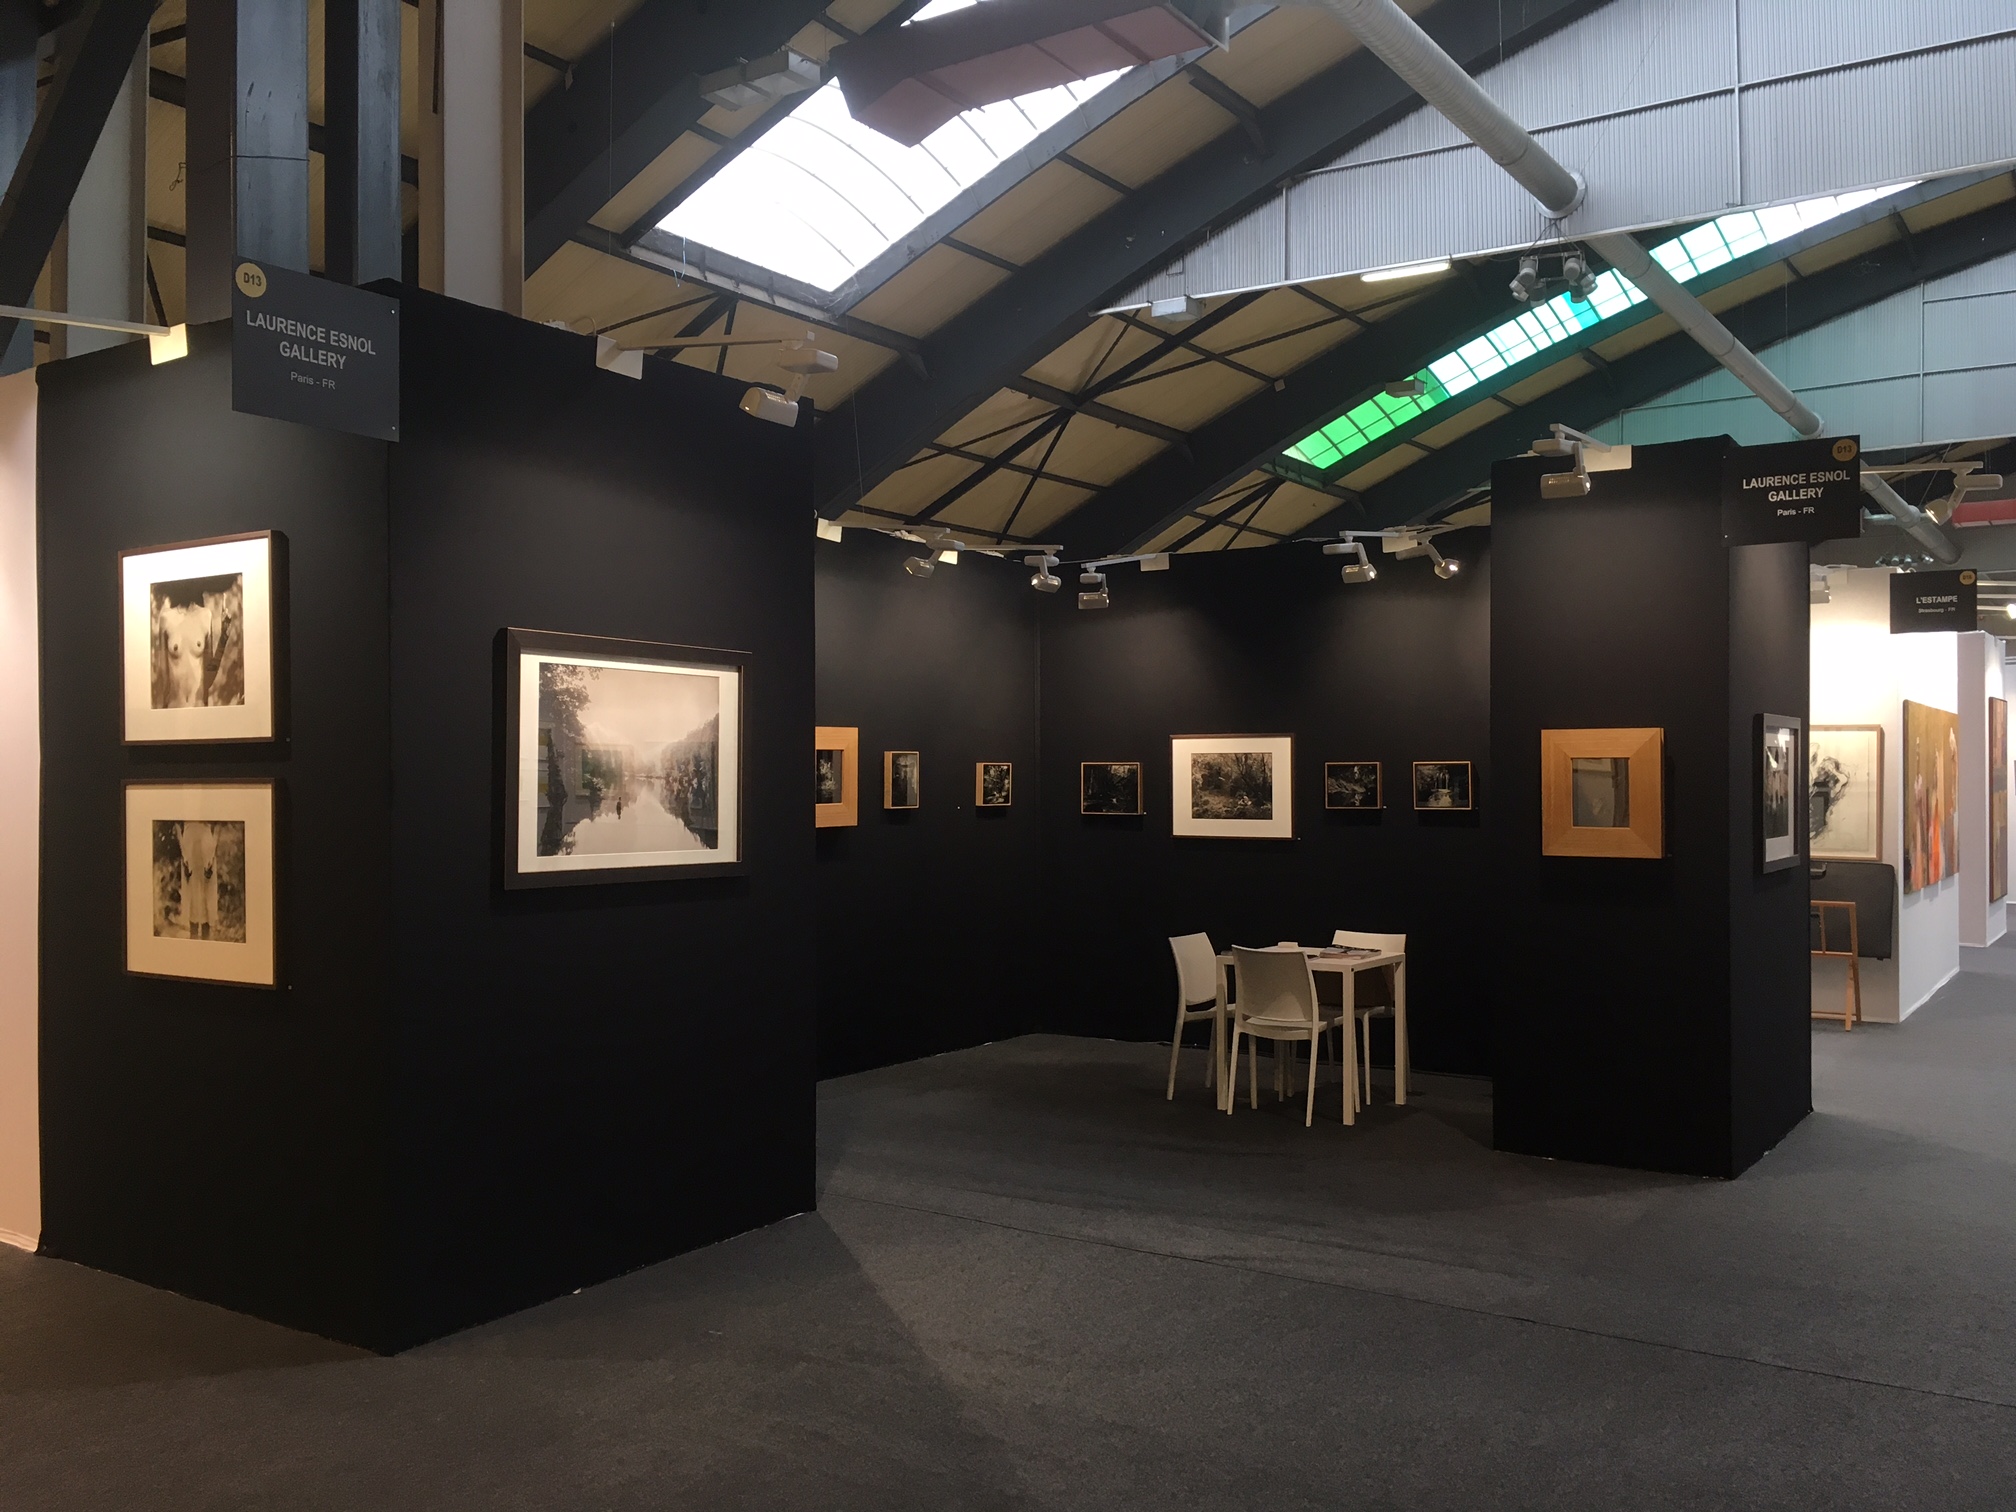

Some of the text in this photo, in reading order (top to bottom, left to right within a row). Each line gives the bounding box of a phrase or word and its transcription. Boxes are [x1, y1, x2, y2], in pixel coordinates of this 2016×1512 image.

[243, 272, 262, 287] D13
[246, 310, 376, 355] LAURENCE ESNOL
[279, 341, 347, 370] GALLERY
[290, 371, 314, 385] Paris
[322, 378, 336, 390] FR
[1837, 445, 1852, 454] D13
[1742, 470, 1850, 489] LAURENCE ESNOL
[1768, 487, 1824, 502] GALLERY
[1777, 508, 1797, 517] Paris
[1916, 595, 1958, 604] L'ESTAMPE
